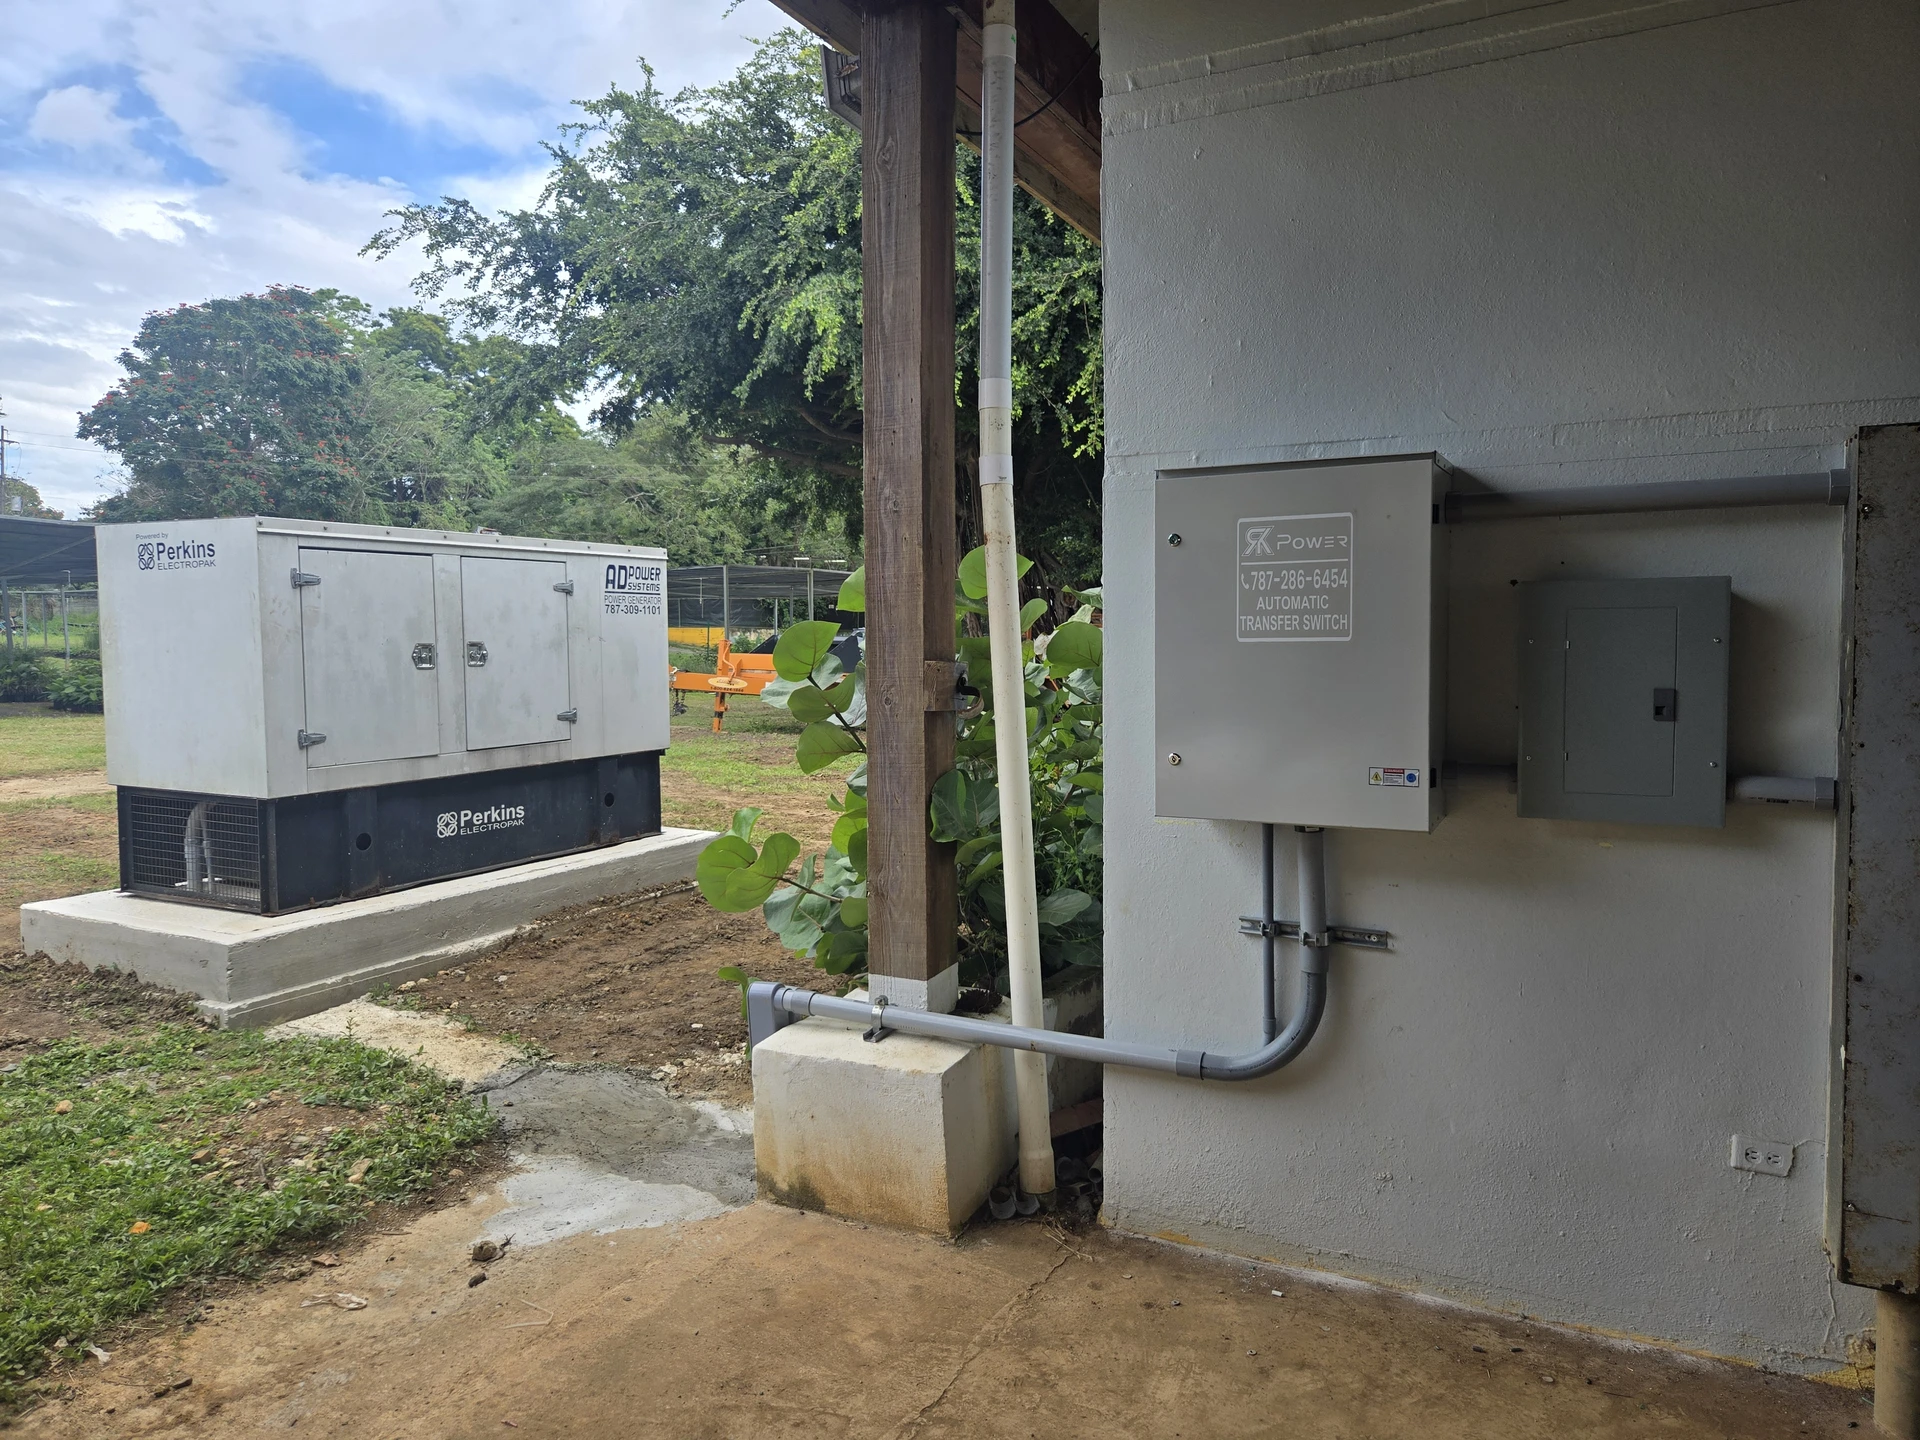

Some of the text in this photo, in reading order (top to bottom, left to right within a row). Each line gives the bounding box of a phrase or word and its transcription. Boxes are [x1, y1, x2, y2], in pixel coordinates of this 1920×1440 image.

[156, 539, 216, 561] Perkins
[157, 559, 217, 571] ELECTROPAK
[605, 564, 661, 590] AD POWER
[1250, 568, 1348, 591] 787-286-6454
[604, 594, 662, 606] POWER GENERATOR
[1256, 595, 1329, 611] AUTOMATIC
[605, 604, 661, 615] 787-309-1101
[1239, 614, 1348, 631] TRANSFER SWITCH
[460, 804, 525, 828] Perkins
[460, 818, 525, 836] ELECTROPAK
